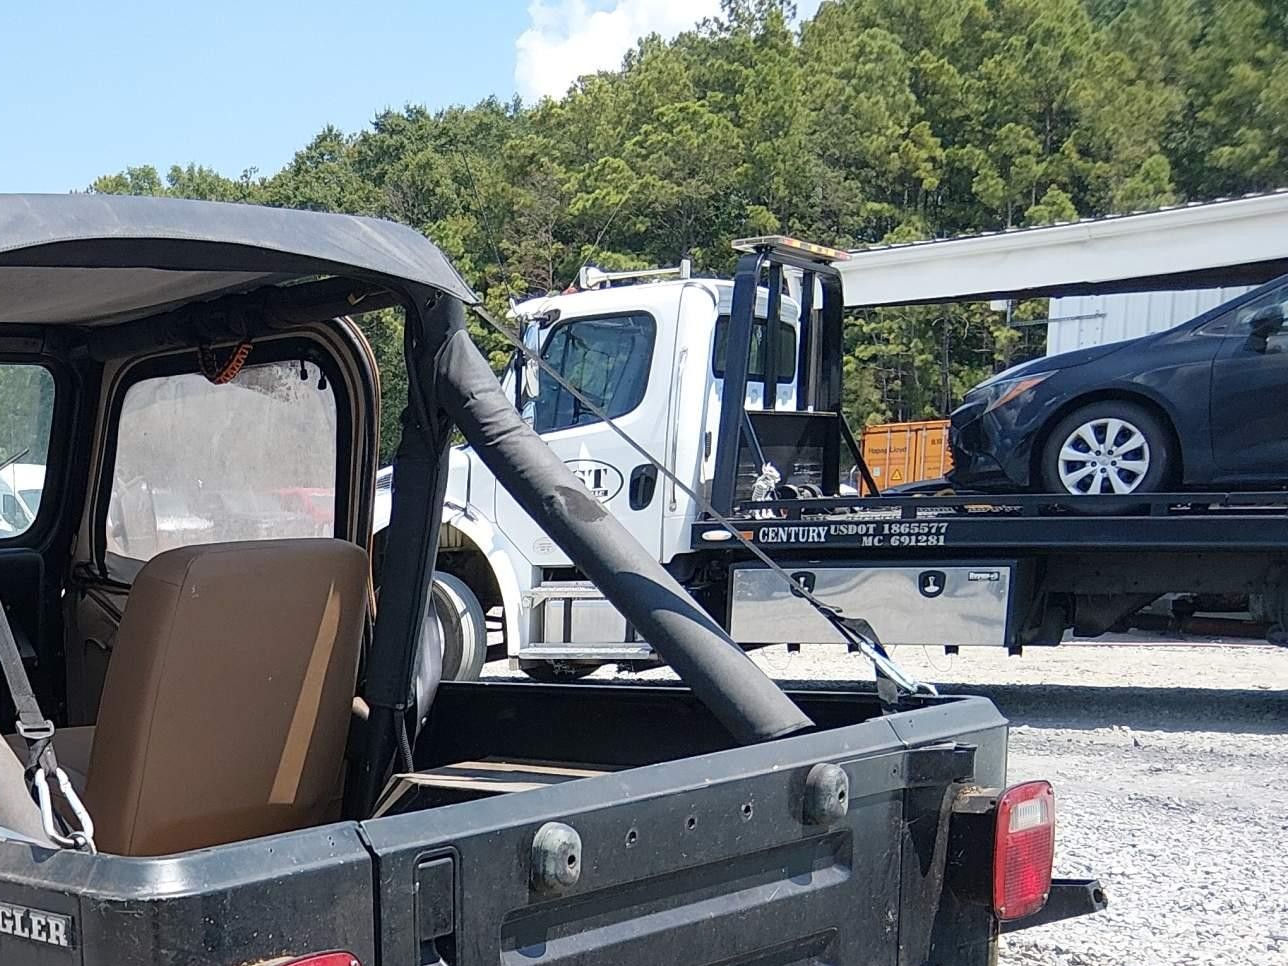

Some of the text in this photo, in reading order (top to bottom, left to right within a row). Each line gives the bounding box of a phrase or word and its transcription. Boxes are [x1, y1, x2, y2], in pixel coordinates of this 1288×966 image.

[758, 526, 828, 543] CENTURY
[830, 522, 948, 535] USDOT 1865577
[861, 535, 945, 547] MC 691281
